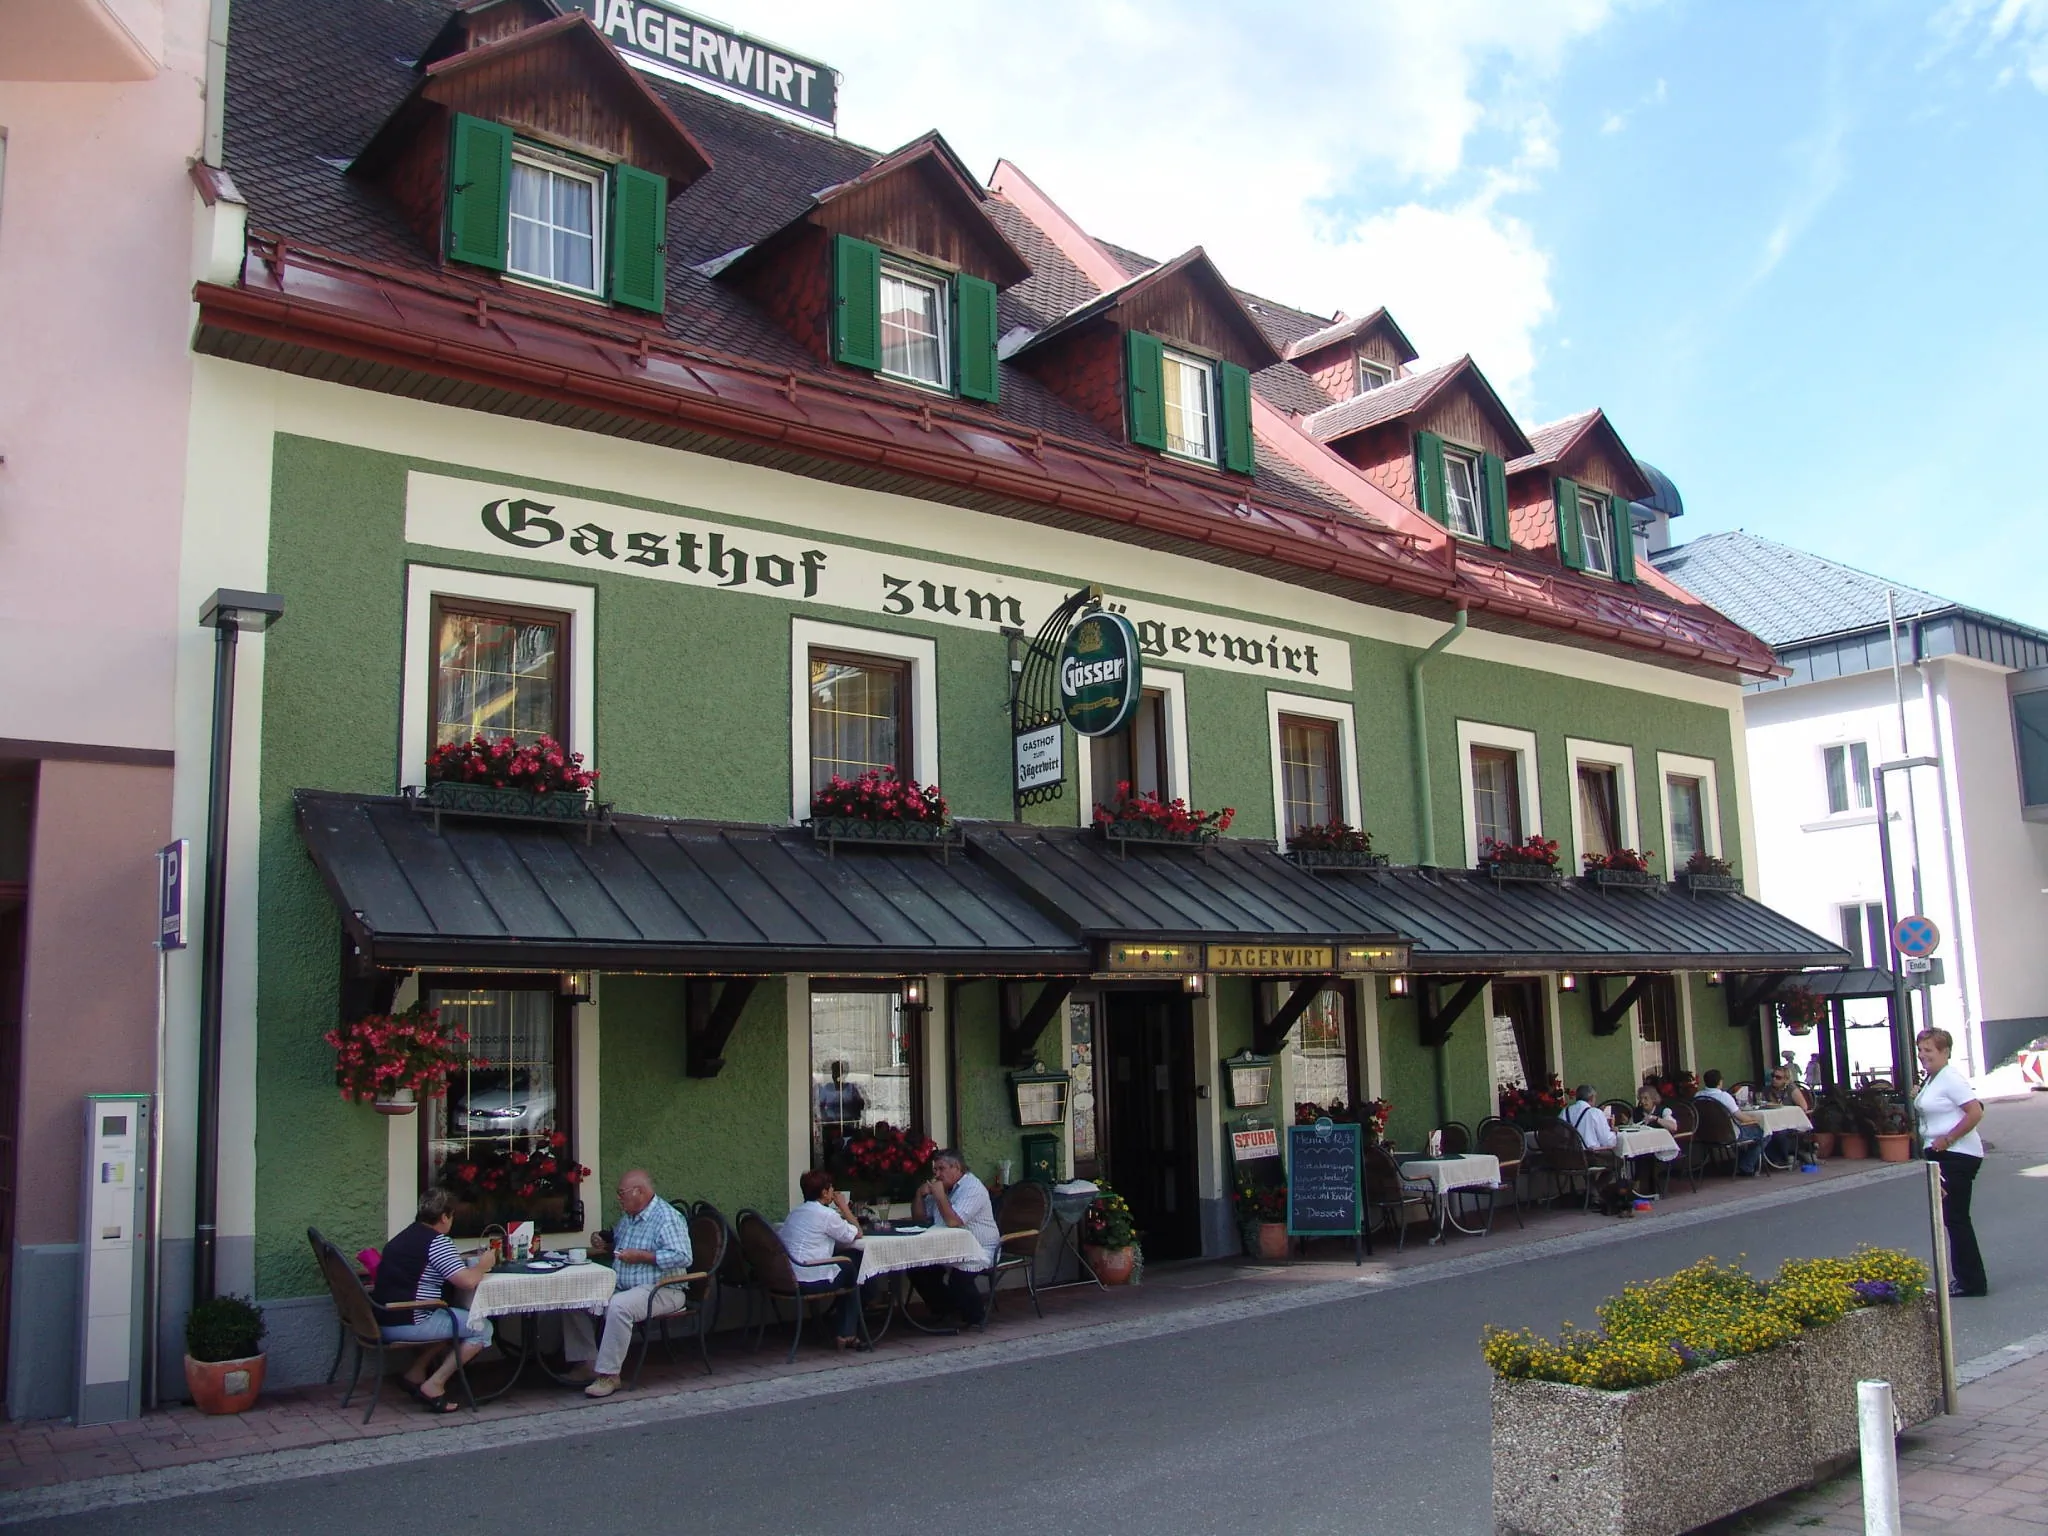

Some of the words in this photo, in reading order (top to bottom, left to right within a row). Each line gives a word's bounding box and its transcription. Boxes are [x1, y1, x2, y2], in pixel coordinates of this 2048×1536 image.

[481, 498, 828, 599] Gasthof
[882, 573, 1026, 627] zum
[1066, 602, 1320, 677] gerwirt
[1060, 656, 1125, 697] Gösser
[1022, 735, 1055, 752] GASTHOF
[1033, 750, 1046, 759] zum
[1019, 757, 1059, 782] Jägerwirt
[166, 850, 178, 912] P
[1909, 961, 1926, 970] Ende
[1234, 1130, 1276, 1149] STURM
[1306, 1206, 1345, 1218] Dessert
